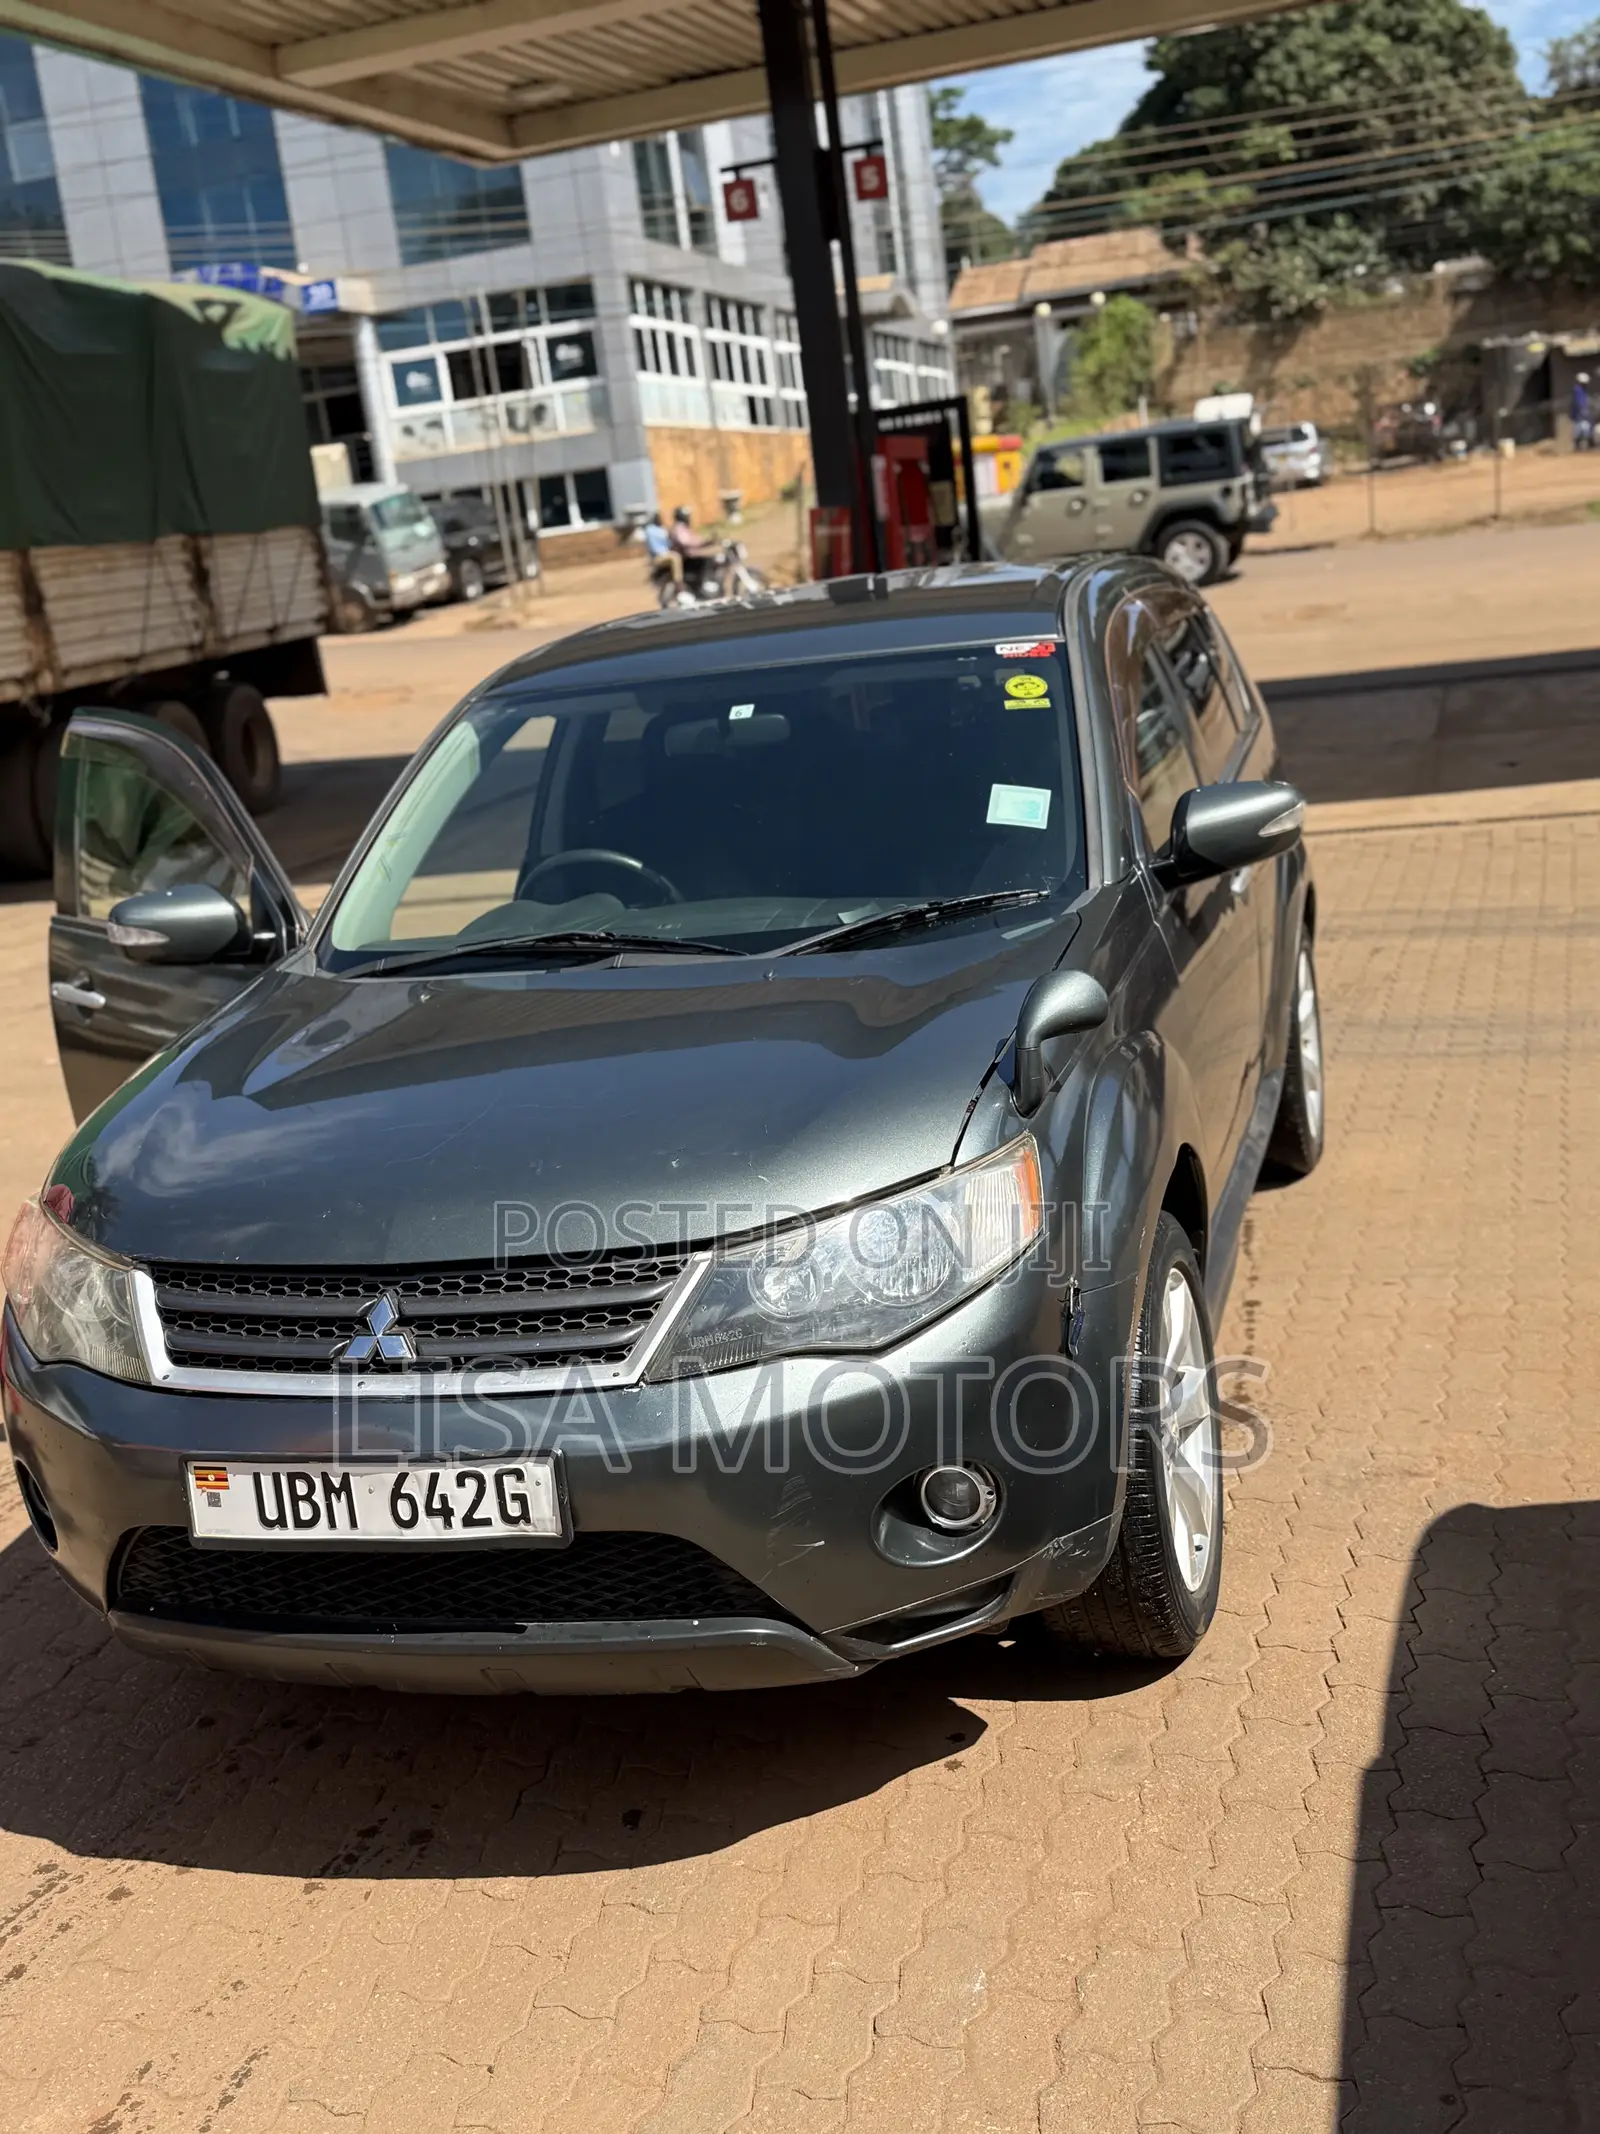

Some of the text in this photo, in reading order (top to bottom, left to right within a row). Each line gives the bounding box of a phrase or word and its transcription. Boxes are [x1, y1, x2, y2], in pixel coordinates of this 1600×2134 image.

[729, 187, 749, 214] 6
[252, 1466, 531, 1531] UBM 642G
